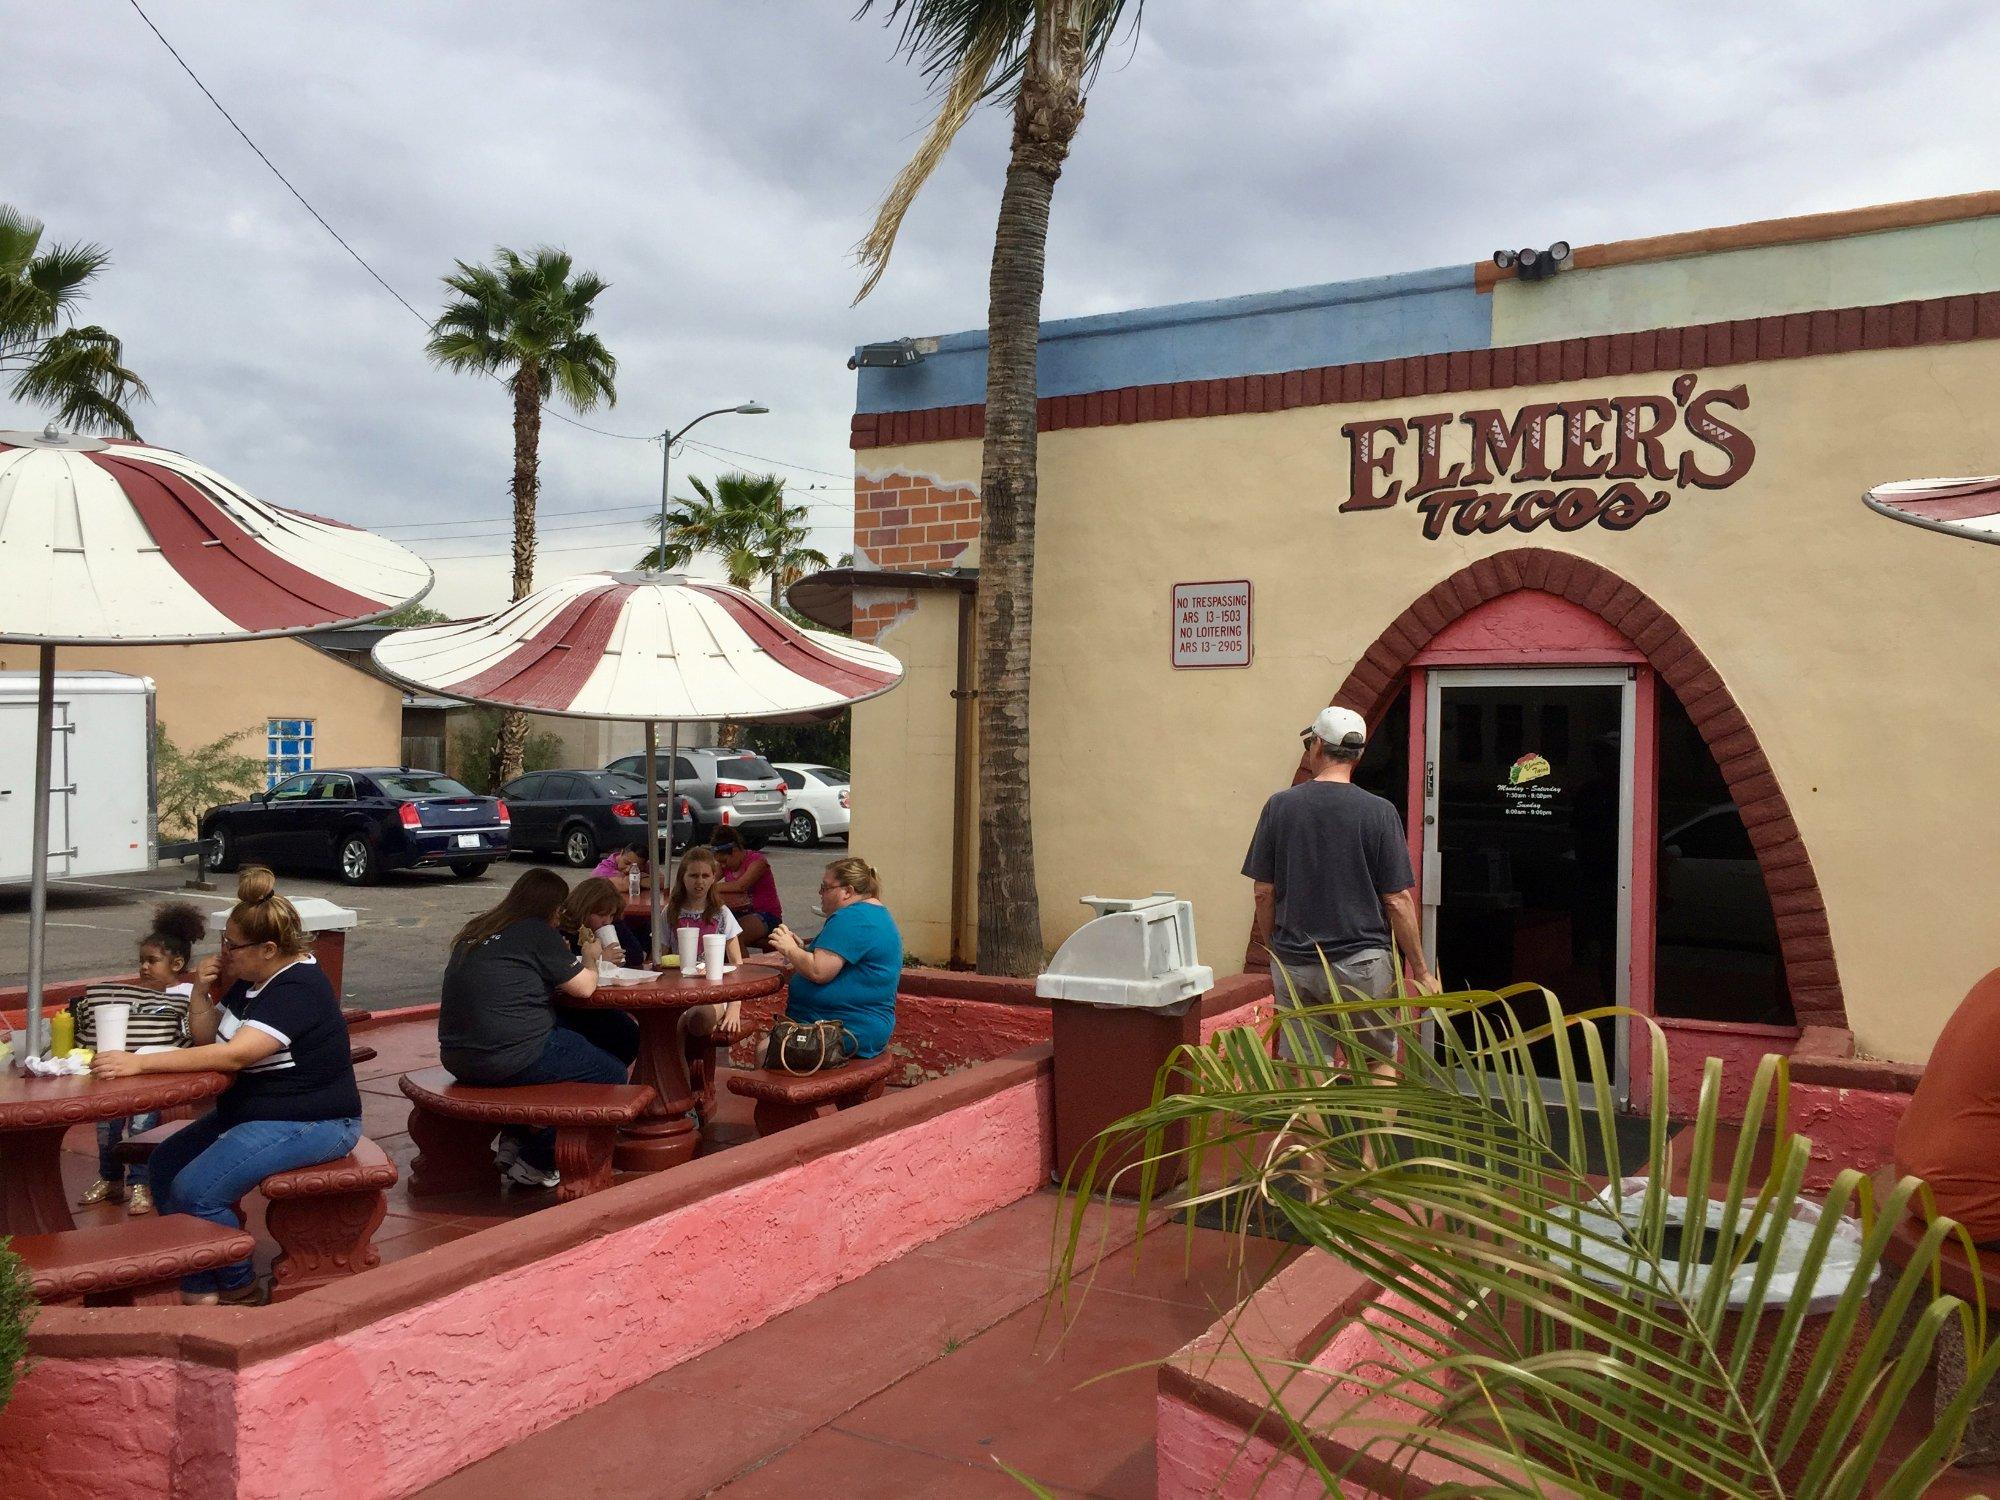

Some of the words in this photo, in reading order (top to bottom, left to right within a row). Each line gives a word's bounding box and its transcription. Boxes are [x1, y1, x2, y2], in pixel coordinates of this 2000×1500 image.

[1339, 374, 1756, 514] ELMER'S
[1418, 483, 1671, 540] Tacos
[1177, 598, 1188, 608] NO
[1192, 595, 1247, 608] TRESPASSING
[1182, 611, 1199, 624] ARS
[1180, 627, 1193, 638] NO
[1196, 625, 1242, 638] LOITERING
[1179, 642, 1198, 653] ARS
[1497, 784, 1524, 793] Monday
[1531, 785, 1562, 793] Saturday
[1516, 801, 1541, 809] Sunday
